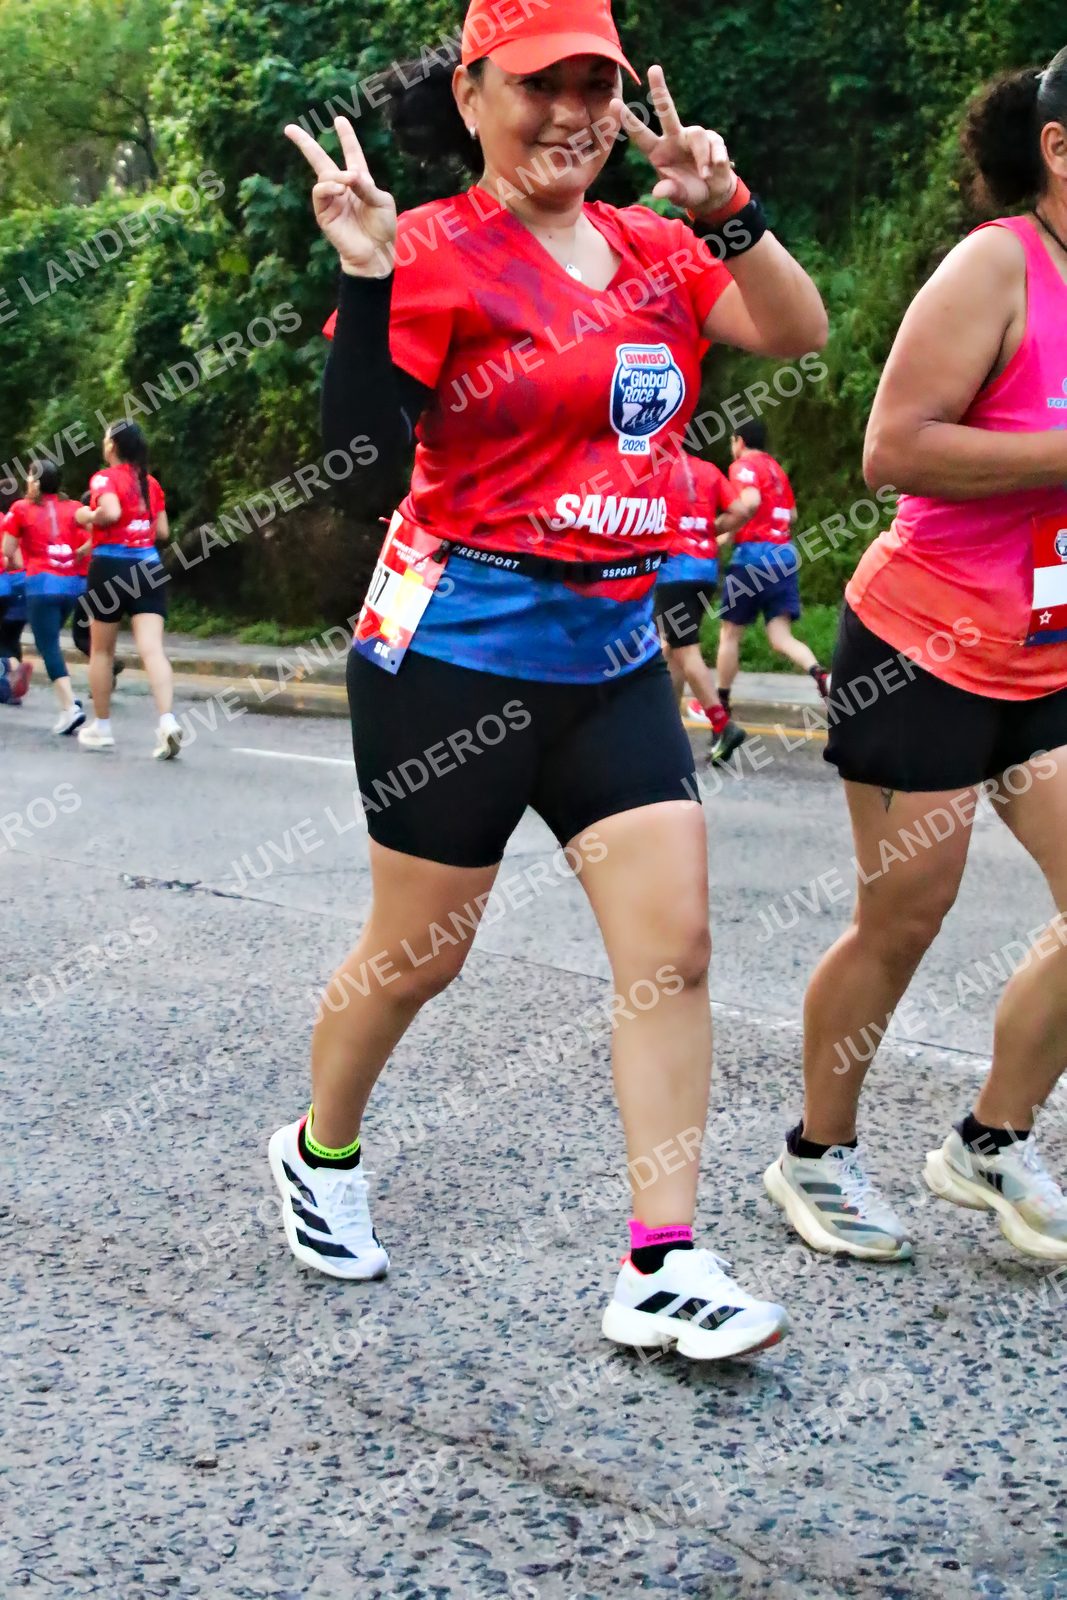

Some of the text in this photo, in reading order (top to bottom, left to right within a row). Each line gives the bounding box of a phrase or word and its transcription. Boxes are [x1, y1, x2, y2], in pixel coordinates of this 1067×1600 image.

[625, 353, 667, 365] BIMBO
[630, 370, 668, 388] Global
[622, 385, 655, 403] Race
[622, 438, 646, 452] 2026
[602, 565, 637, 578] SSPORT
[373, 641, 391, 659] 5K
